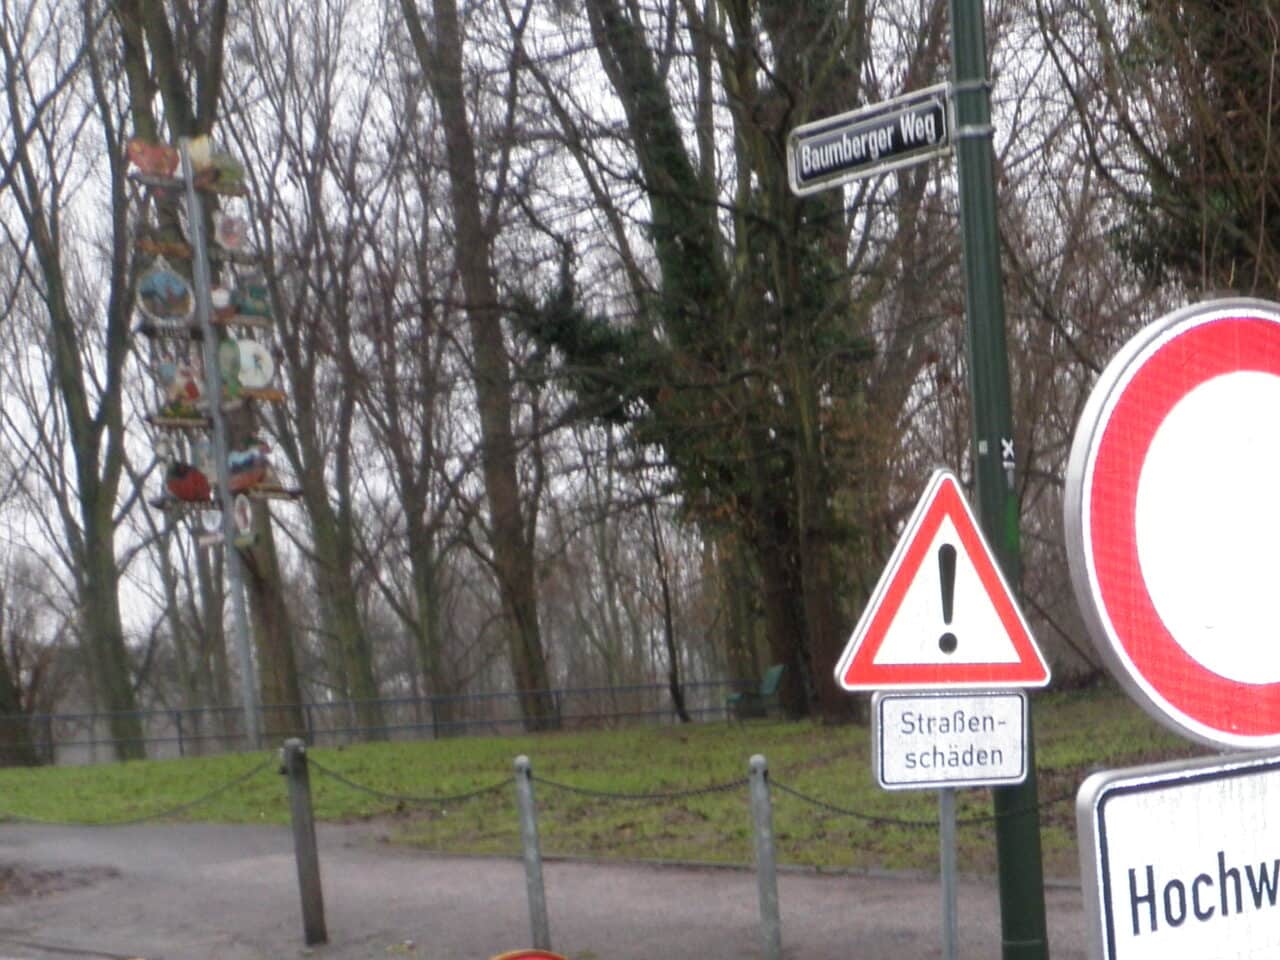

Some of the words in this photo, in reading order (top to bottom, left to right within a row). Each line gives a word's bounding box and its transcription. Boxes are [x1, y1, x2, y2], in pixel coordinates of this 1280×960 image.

[802, 124, 894, 175] Baumberger
[900, 111, 936, 145] Weg
[901, 710, 1007, 735] Straßen-
[905, 744, 1003, 769] schäden
